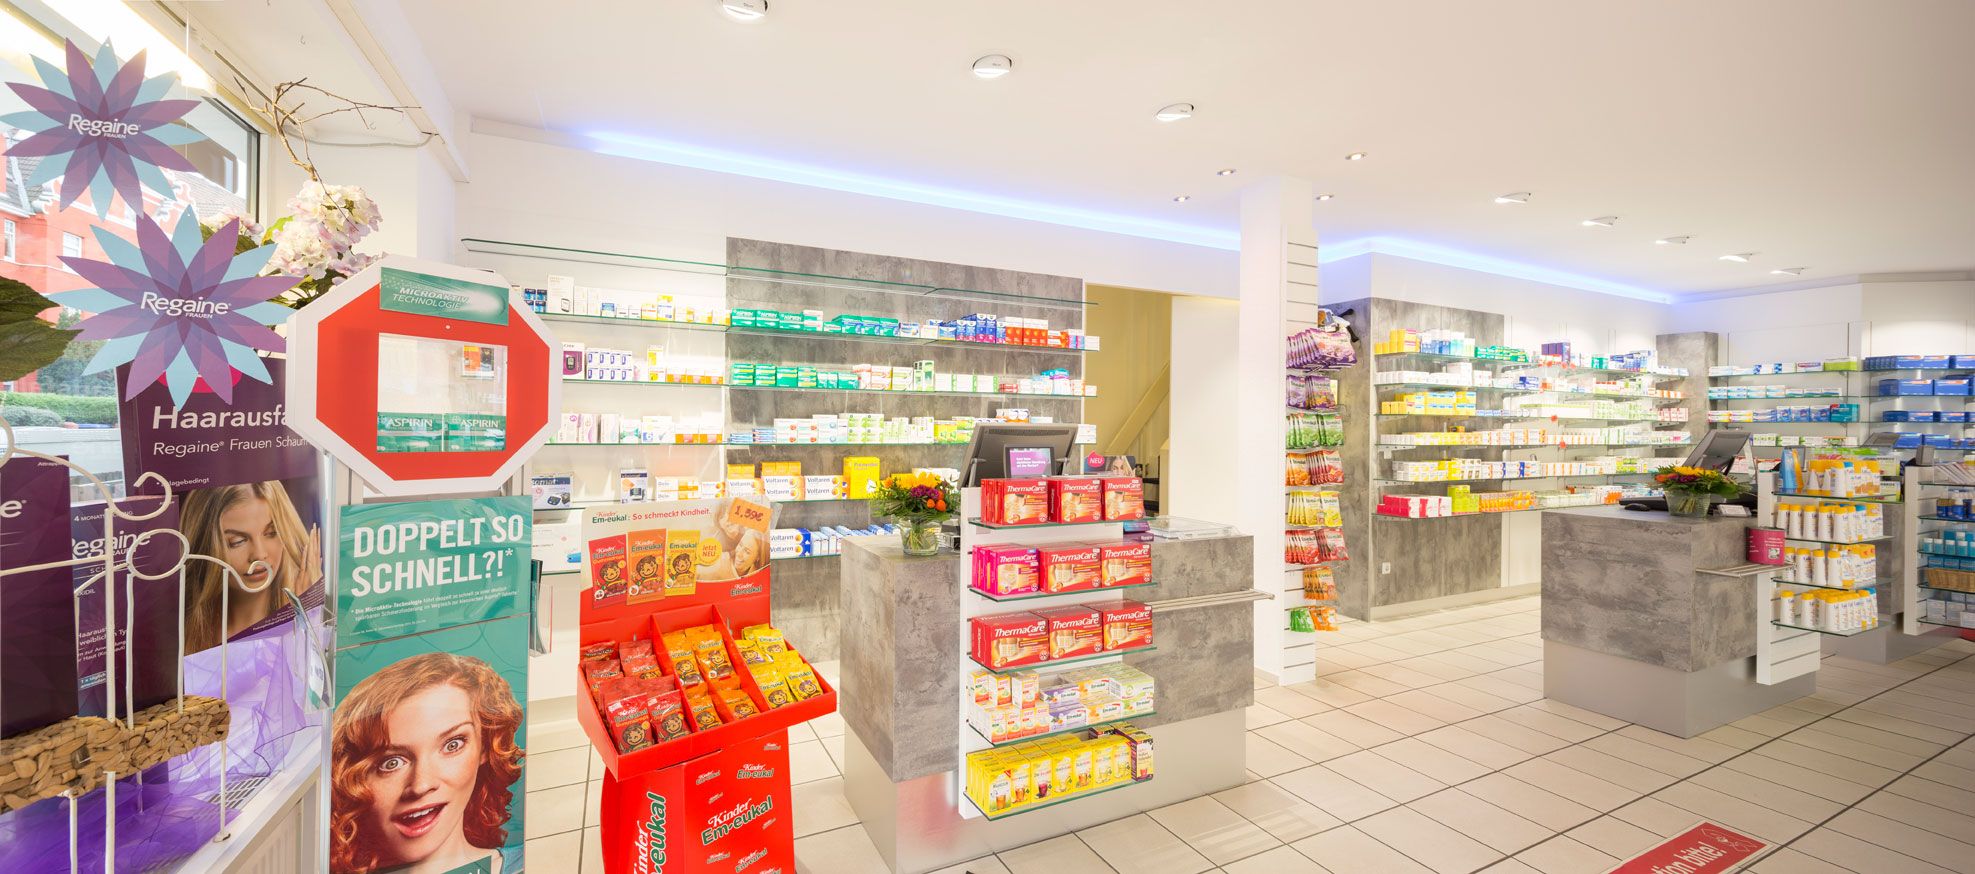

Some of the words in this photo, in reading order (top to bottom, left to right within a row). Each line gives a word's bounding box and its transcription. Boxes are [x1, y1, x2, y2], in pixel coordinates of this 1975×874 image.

[68, 114, 140, 137] Regaine
[140, 291, 228, 317] Regaine
[388, 418, 433, 428] ASPIRIN
[460, 419, 499, 428] ASPIRIN
[230, 437, 272, 451] Frauen
[1089, 457, 1103, 465] NEU
[168, 476, 210, 487] lagebedingt
[1063, 483, 1099, 491] ThermaCare
[1107, 482, 1141, 490] ThermaCare
[1007, 485, 1046, 493] ThermaCare
[632, 513, 643, 521] So
[644, 510, 680, 519] schmeckt
[680, 508, 711, 517] Kindheit.
[353, 517, 486, 558] DOPPELT
[491, 514, 524, 544] SO
[1000, 553, 1037, 563] ThermaCare
[1051, 552, 1098, 564] ThermaCare
[1105, 547, 1149, 558] ThermaCare
[1106, 610, 1150, 622] ThermaCare
[1052, 617, 1099, 630] ThermaCare
[994, 625, 1046, 638] ThermaCare
[736, 768, 775, 779] Em-eukal
[743, 763, 765, 772] Kinder
[707, 798, 752, 828] Kinder
[700, 794, 774, 846] Em-eukal
[1673, 841, 1727, 868] bitte!
